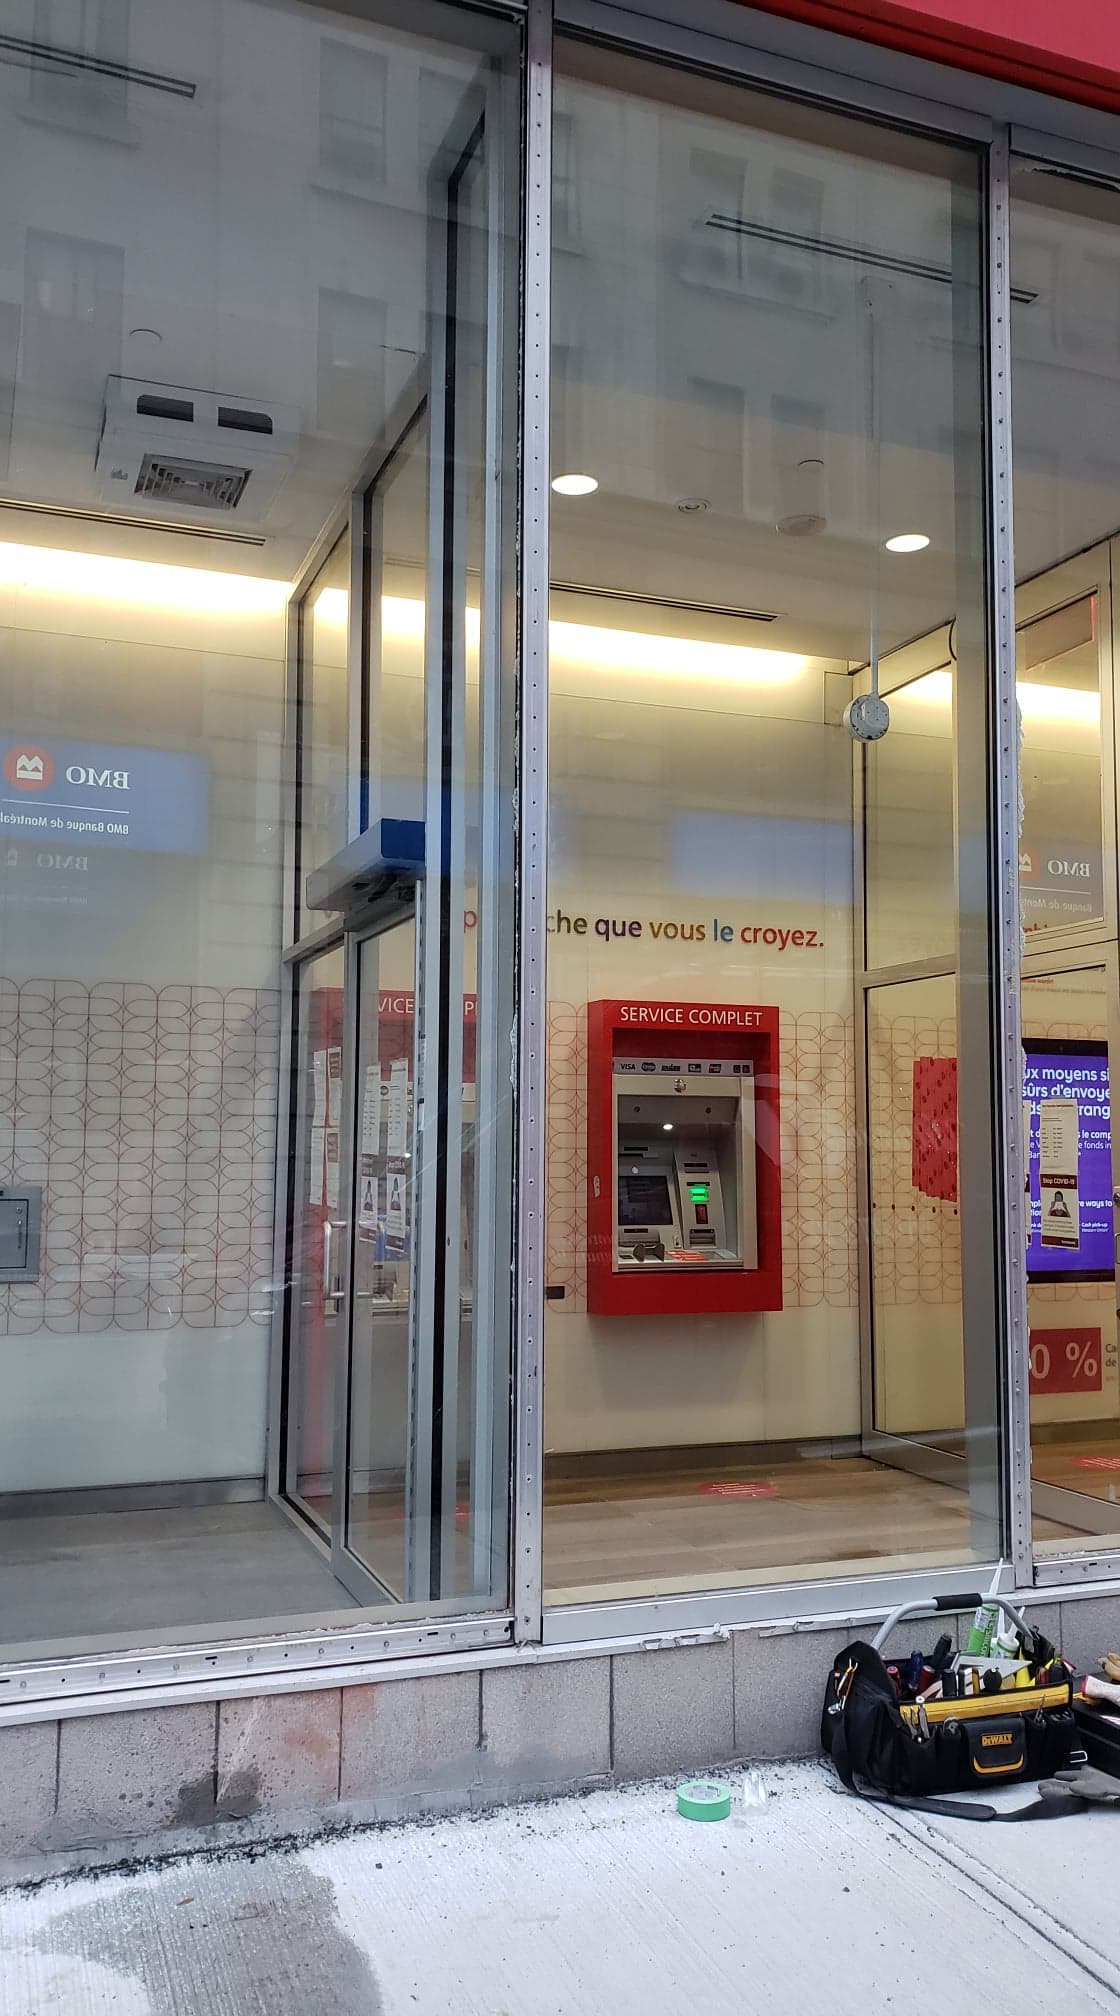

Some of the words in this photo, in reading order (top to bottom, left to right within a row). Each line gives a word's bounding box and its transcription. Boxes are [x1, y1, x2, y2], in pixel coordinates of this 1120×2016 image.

[594, 917, 642, 941] que
[649, 921, 706, 941] vous
[713, 918, 734, 942] le
[740, 925, 824, 951] croyez.
[620, 1006, 684, 1024] SERVICE
[688, 1008, 762, 1026] COMPLET
[1042, 1068, 1097, 1083] moyens
[1084, 1140, 1104, 1149] fonds
[1086, 1200, 1104, 1208] ways
[1105, 1199, 1113, 1207] to
